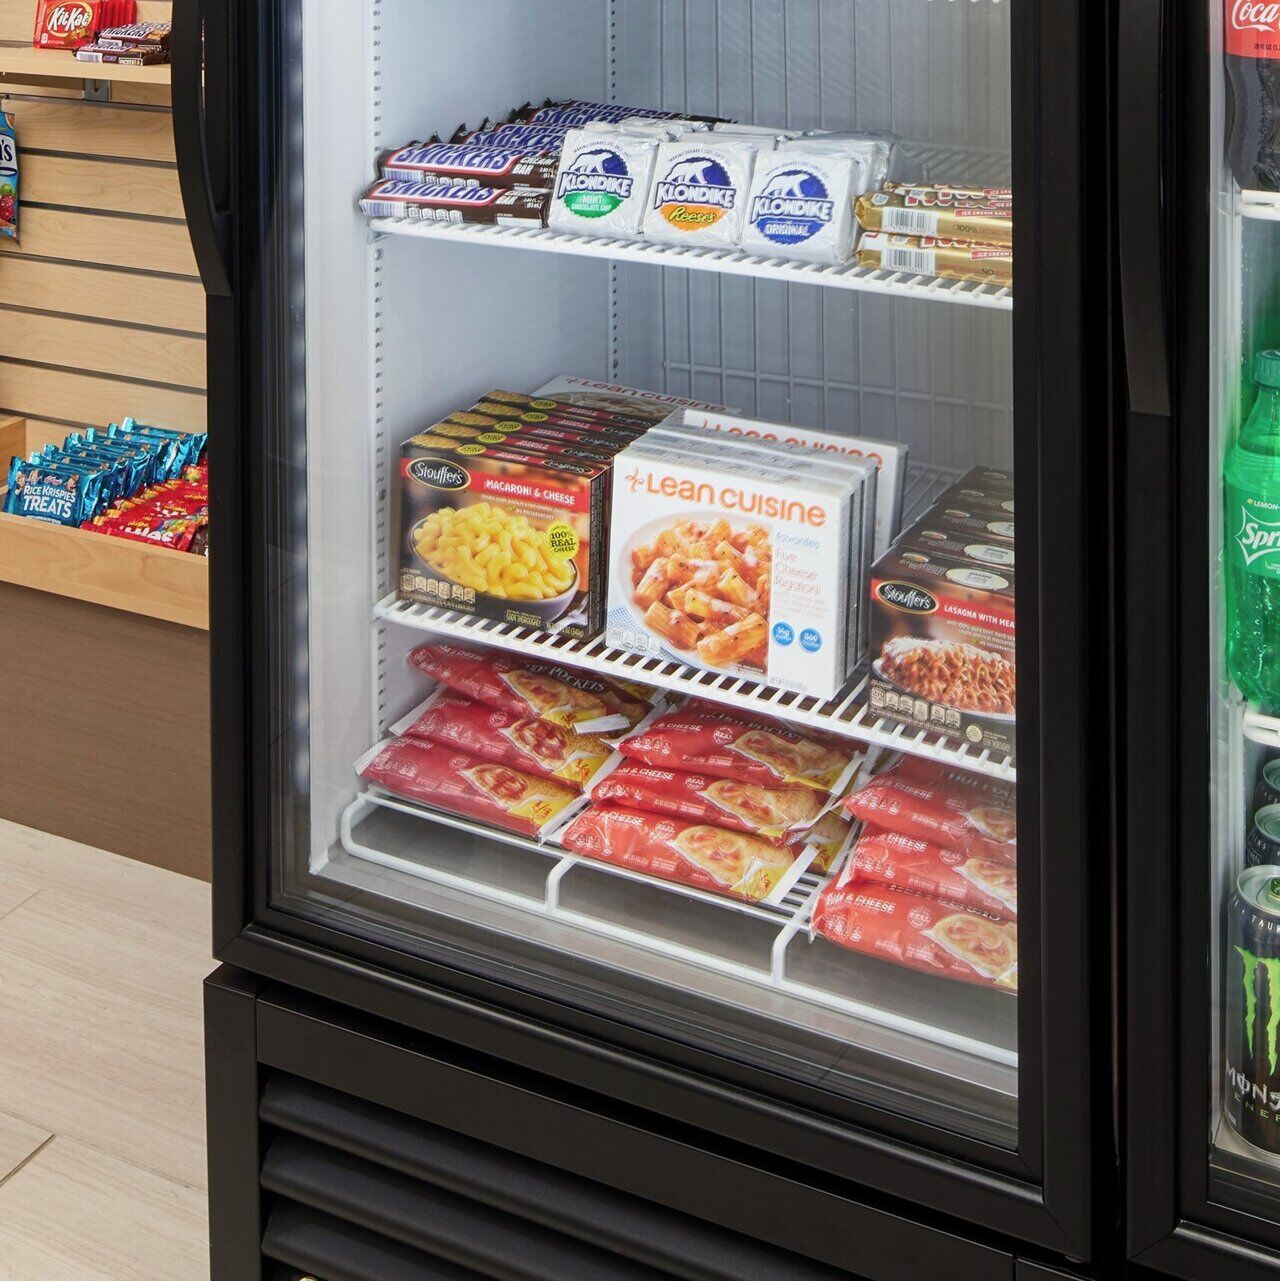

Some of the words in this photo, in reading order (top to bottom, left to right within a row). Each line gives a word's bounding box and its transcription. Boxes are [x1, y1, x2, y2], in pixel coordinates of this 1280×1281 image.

[396, 147, 511, 169] SNICKERS
[382, 181, 494, 201] SNICKERS
[559, 172, 633, 199] KLONDIKE
[655, 182, 736, 208] KLONDIKE
[582, 195, 603, 204] MINT
[752, 197, 833, 223] KLONDIKE
[670, 207, 715, 223] Reese's
[416, 464, 463, 484] Stouffer's
[23, 485, 42, 495] RICE
[42, 485, 76, 502] KRISPIES
[484, 479, 531, 495] MACARONI
[543, 491, 575, 505] CHEESE
[647, 472, 715, 503] Lean
[722, 486, 826, 526] cuisine
[23, 496, 71, 518] TREATS
[551, 538, 576, 548] REAL
[884, 585, 931, 610] Stouffer's
[944, 605, 977, 619] LASAGNA
[978, 613, 998, 624] WITH
[639, 768, 675, 780] CHEESE
